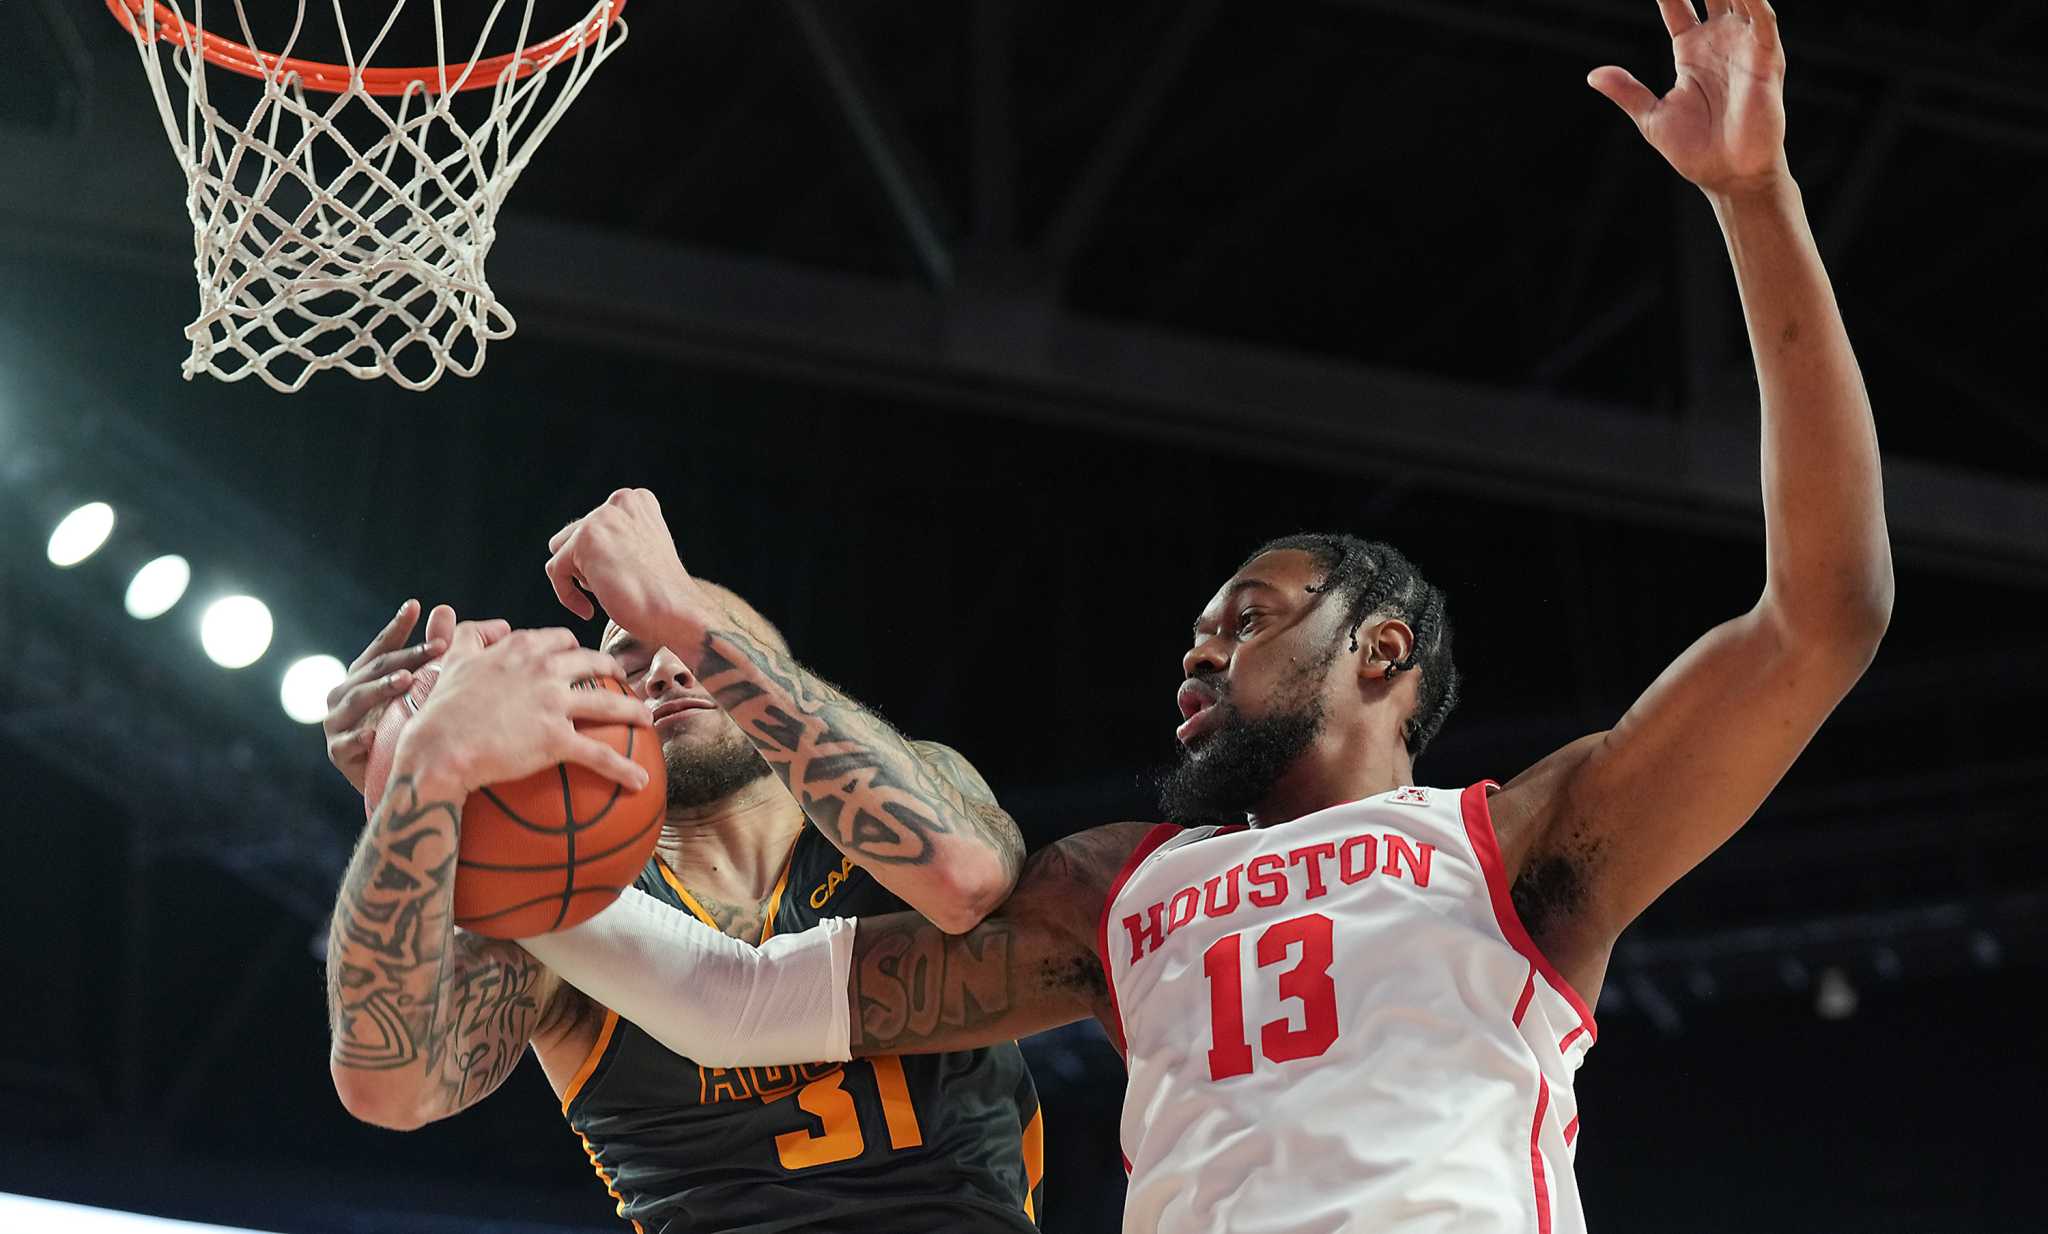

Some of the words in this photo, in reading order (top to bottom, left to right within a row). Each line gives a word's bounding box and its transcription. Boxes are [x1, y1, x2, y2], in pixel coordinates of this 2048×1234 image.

[810, 856, 854, 909] CAA
[1122, 833, 1436, 966] HOUSTON
[1203, 912, 1340, 1082] 13
[774, 1054, 923, 1171] 31
